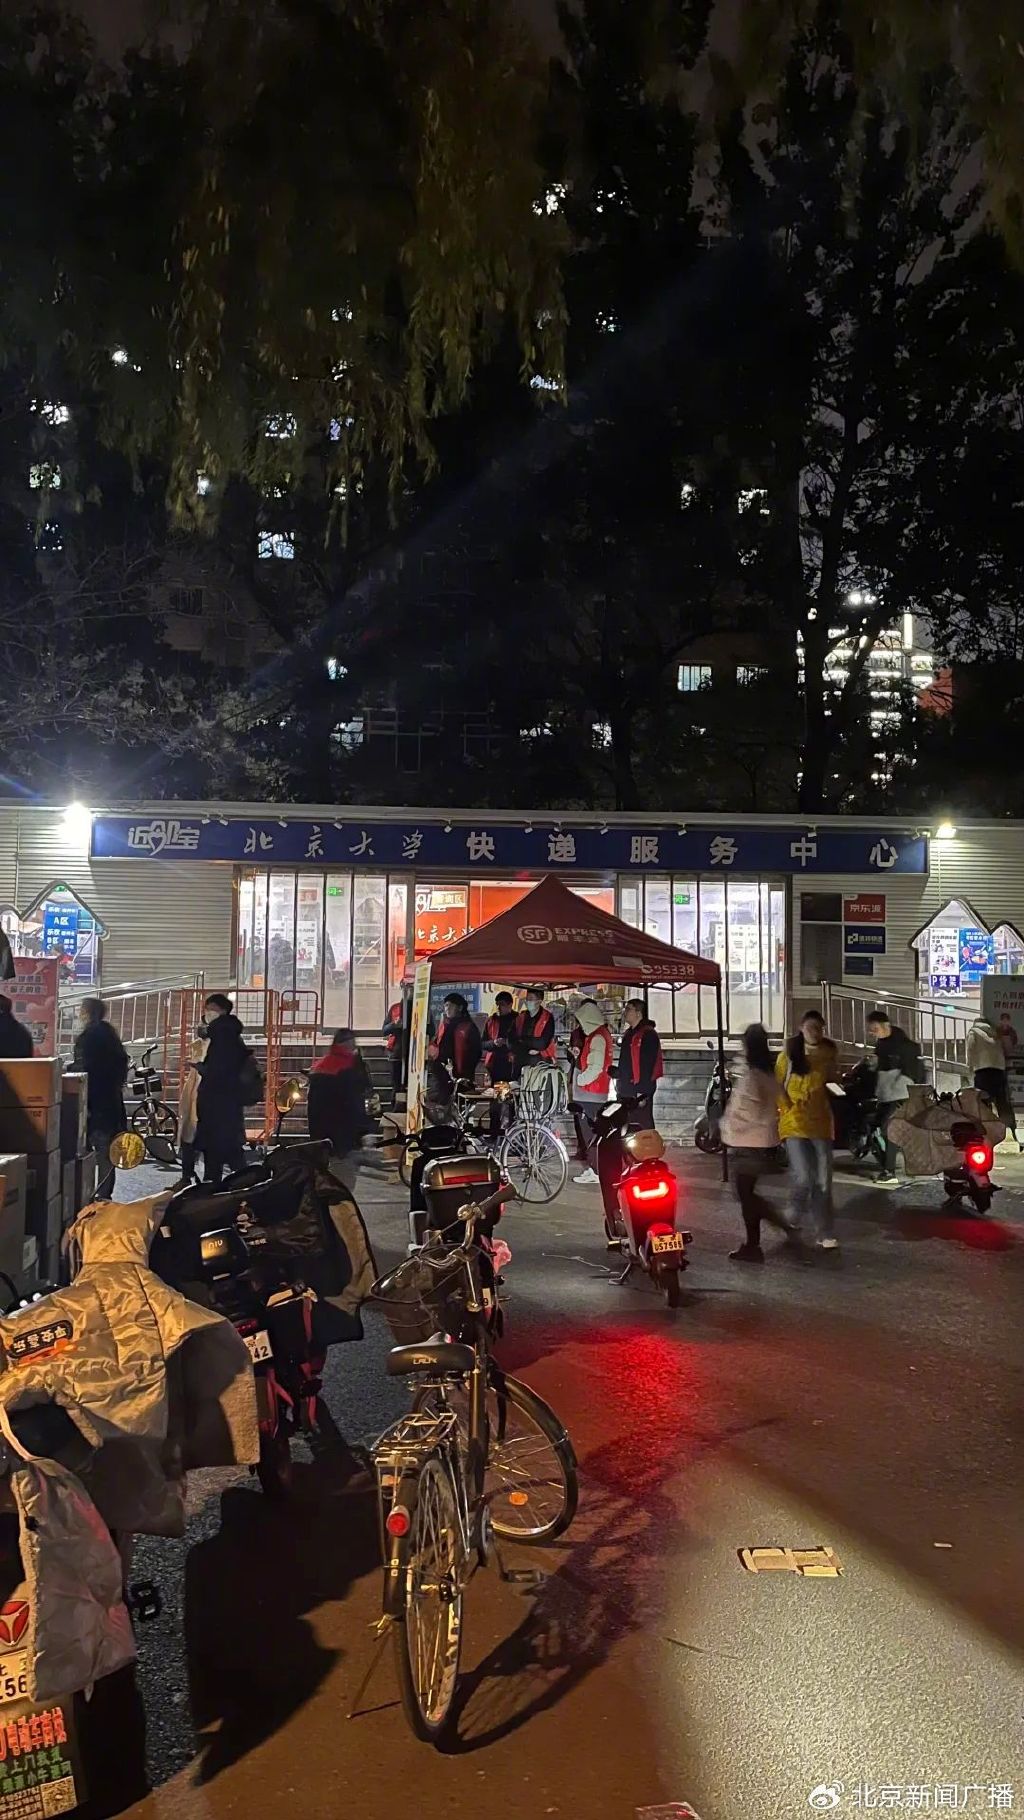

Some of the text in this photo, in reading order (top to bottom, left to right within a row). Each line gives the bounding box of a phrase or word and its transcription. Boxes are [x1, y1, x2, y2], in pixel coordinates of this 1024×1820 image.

[128, 820, 898, 869] 近邻宝 北京大学 快递服务中心
[13, 1326, 67, 1353] 平安喜乐
